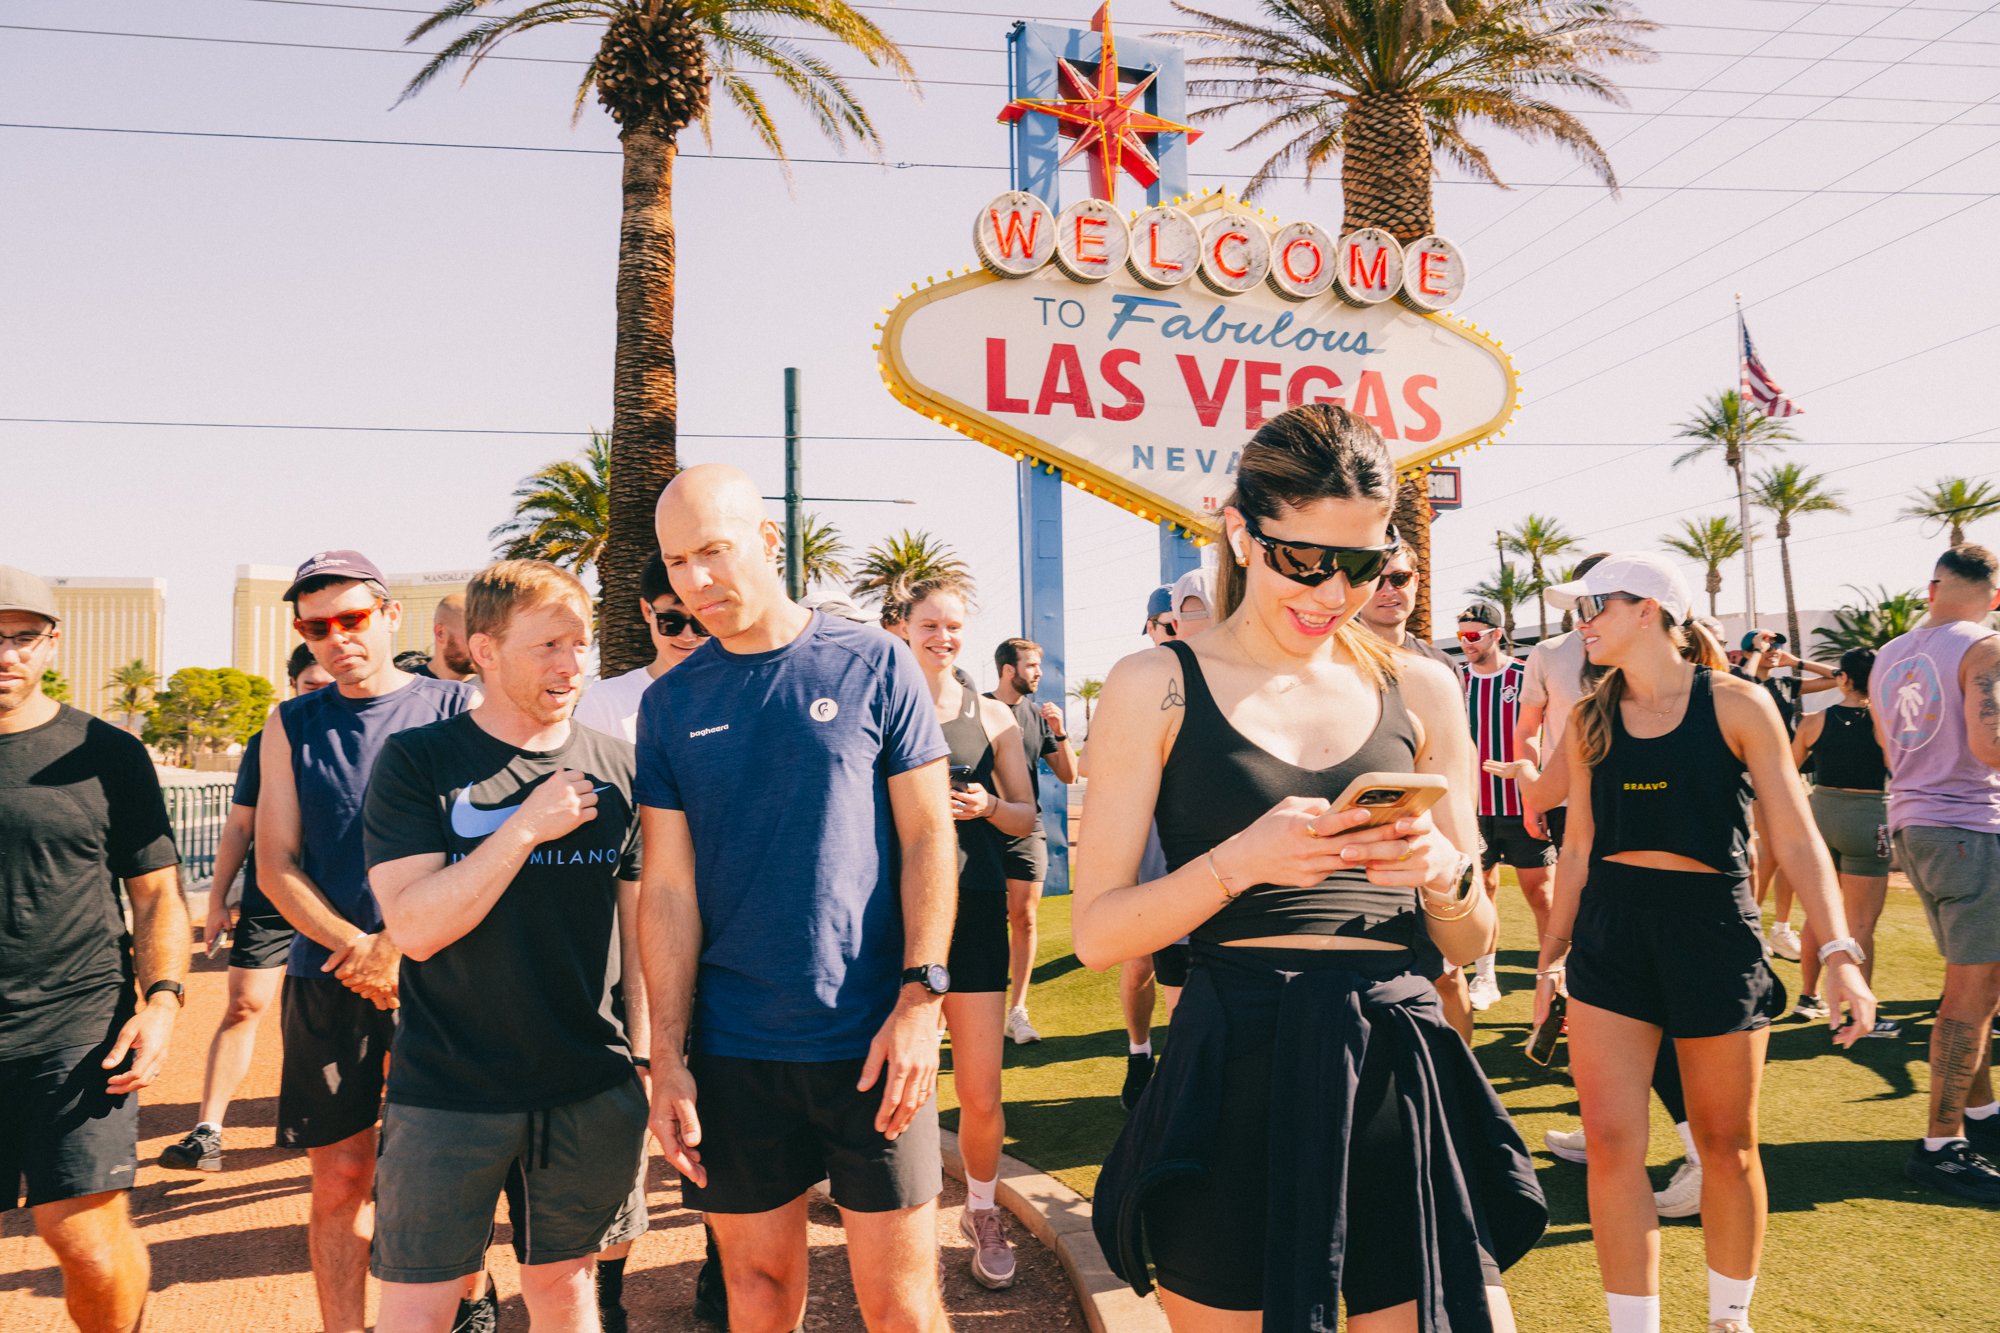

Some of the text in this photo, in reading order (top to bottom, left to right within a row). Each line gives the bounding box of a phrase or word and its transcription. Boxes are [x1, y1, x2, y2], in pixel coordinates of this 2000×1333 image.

[991, 208, 1448, 296] WELCOME
[1033, 293, 1386, 355] TO Fabulous
[986, 337, 1441, 442] LAS VEGAS
[1132, 444, 1241, 474] NEVA
[689, 723, 730, 738] bagheera
[1623, 781, 1667, 790] BRAAVO
[530, 849, 617, 865] MILANO
